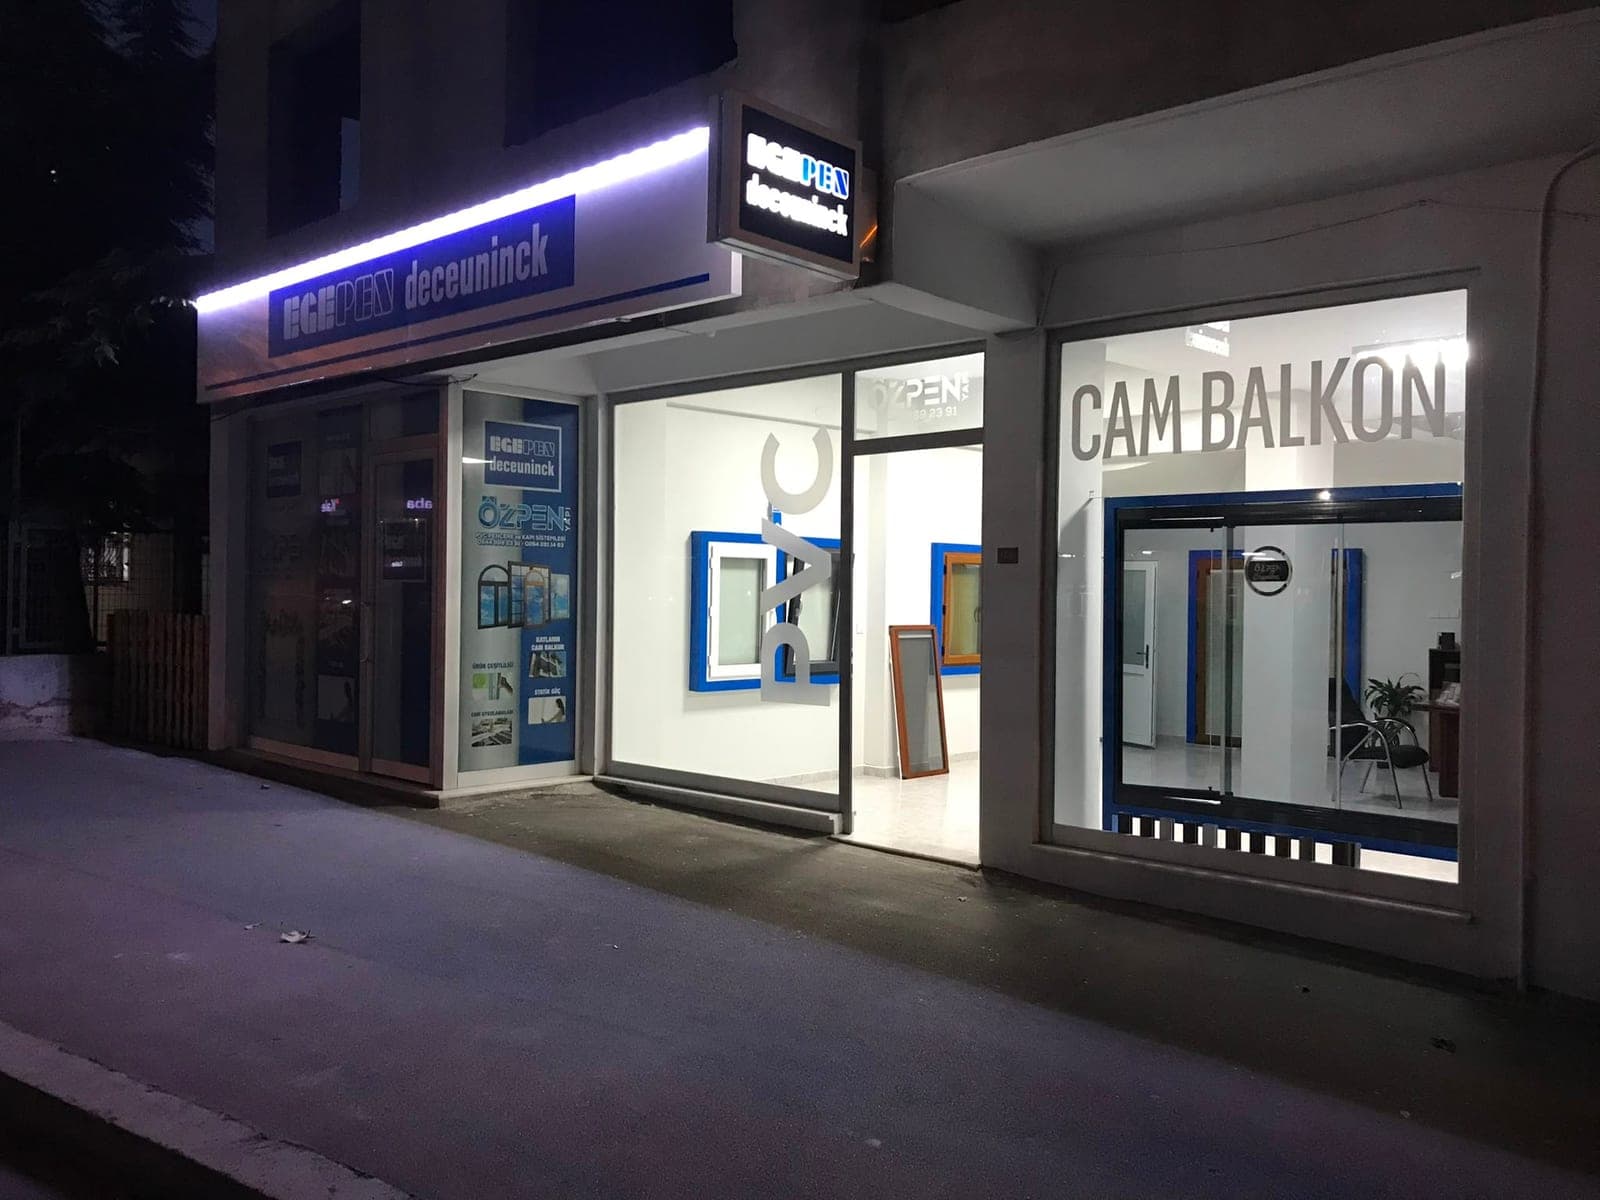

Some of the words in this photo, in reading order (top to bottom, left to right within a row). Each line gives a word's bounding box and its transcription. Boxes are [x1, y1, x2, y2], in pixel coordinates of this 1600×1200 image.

[747, 132, 849, 200] EGEPEN
[746, 172, 848, 236] deceuninck
[283, 268, 395, 341] EGEPEN
[403, 222, 549, 312] deceuninck
[1072, 375, 1182, 461] CAM
[1201, 351, 1447, 453] BALKON
[489, 456, 555, 477] deceuninck
[490, 435, 555, 458] EGEPEN
[478, 496, 565, 532] ÖZPEN
[564, 507, 572, 531] YAPI
[760, 426, 834, 706] PVC
